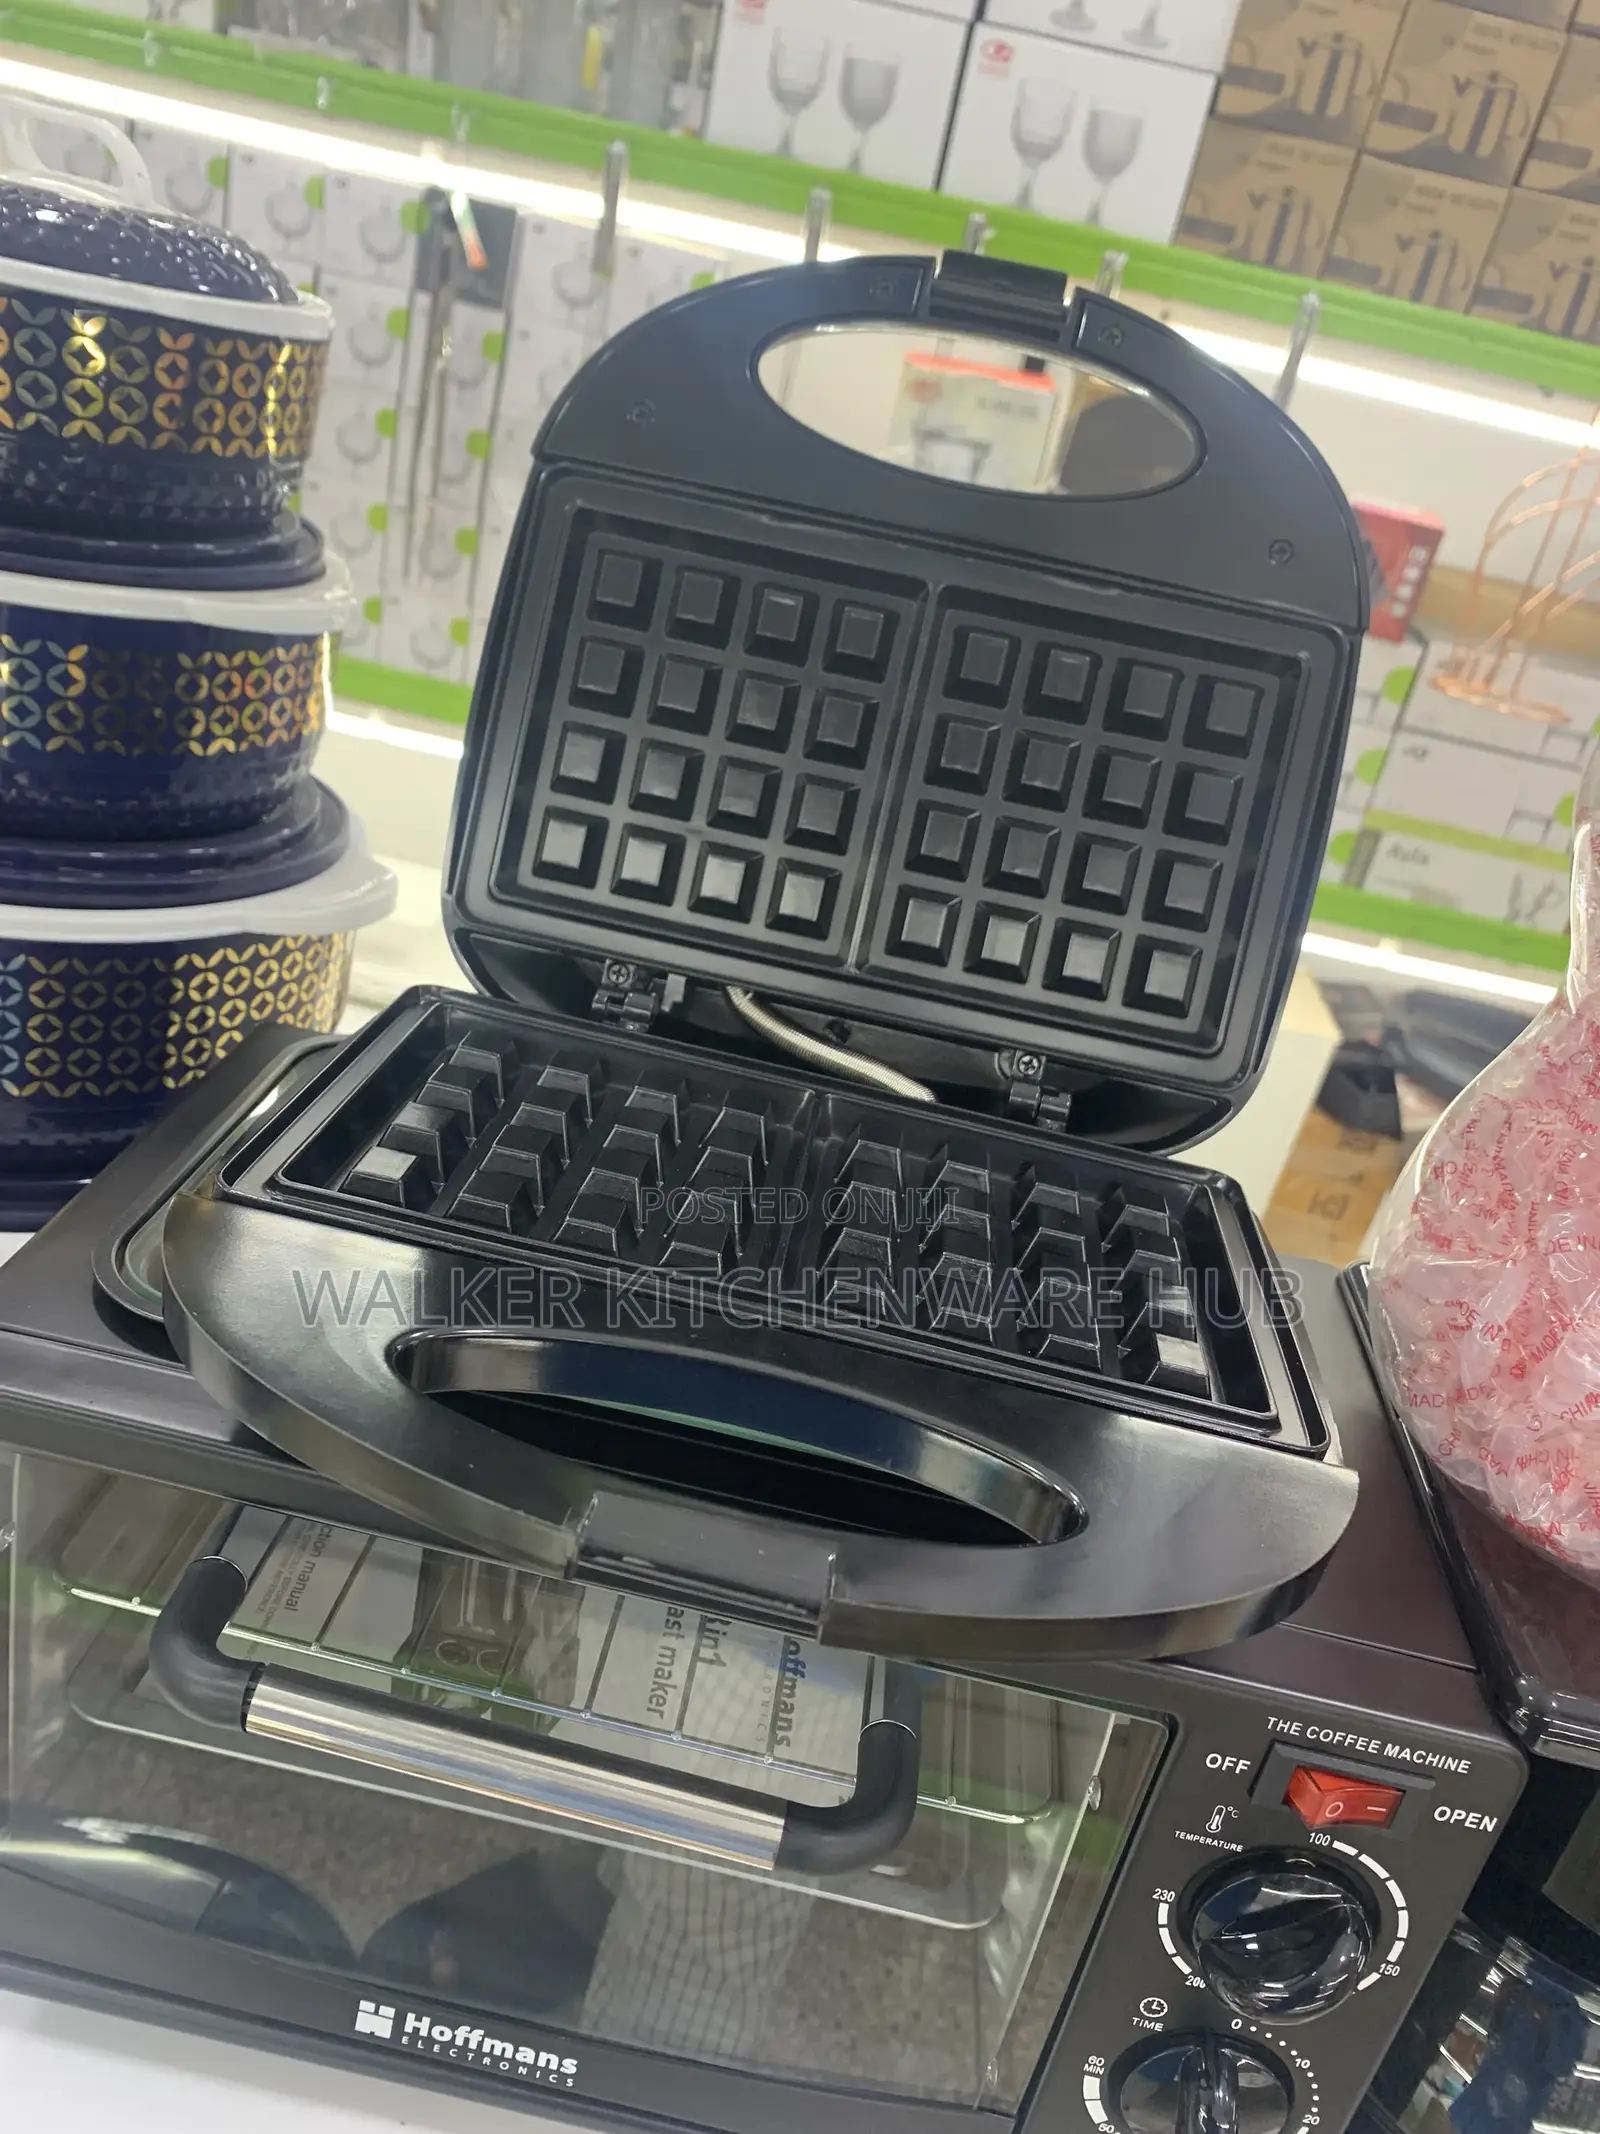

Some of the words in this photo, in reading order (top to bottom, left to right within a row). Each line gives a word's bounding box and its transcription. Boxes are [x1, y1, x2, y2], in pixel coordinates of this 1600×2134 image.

[284, 1563, 317, 1613] manual
[646, 1644, 678, 1721] maker
[1266, 1716, 1302, 1739] THE
[1306, 1726, 1380, 1756] COFFEE
[1383, 1743, 1472, 1775] MACHINE
[1205, 1752, 1251, 1776] OFF
[1433, 1805, 1499, 1833] OPEN
[1174, 1830, 1244, 1853] TEMPERATURE
[1308, 1831, 1331, 1848] 100
[1152, 1888, 1175, 1903] 230
[1379, 1963, 1401, 1978] 150
[1131, 2017, 1164, 2033] TIME
[1231, 2018, 1243, 2031] 0
[403, 2012, 579, 2076] Hoffmans
[401, 2036, 575, 2088] ELECTRONICS
[1083, 2063, 1105, 2076] MIN
[1088, 2055, 1105, 2067] 60
[1294, 2057, 1311, 2070] 10
[1303, 2114, 1321, 2126] 20
